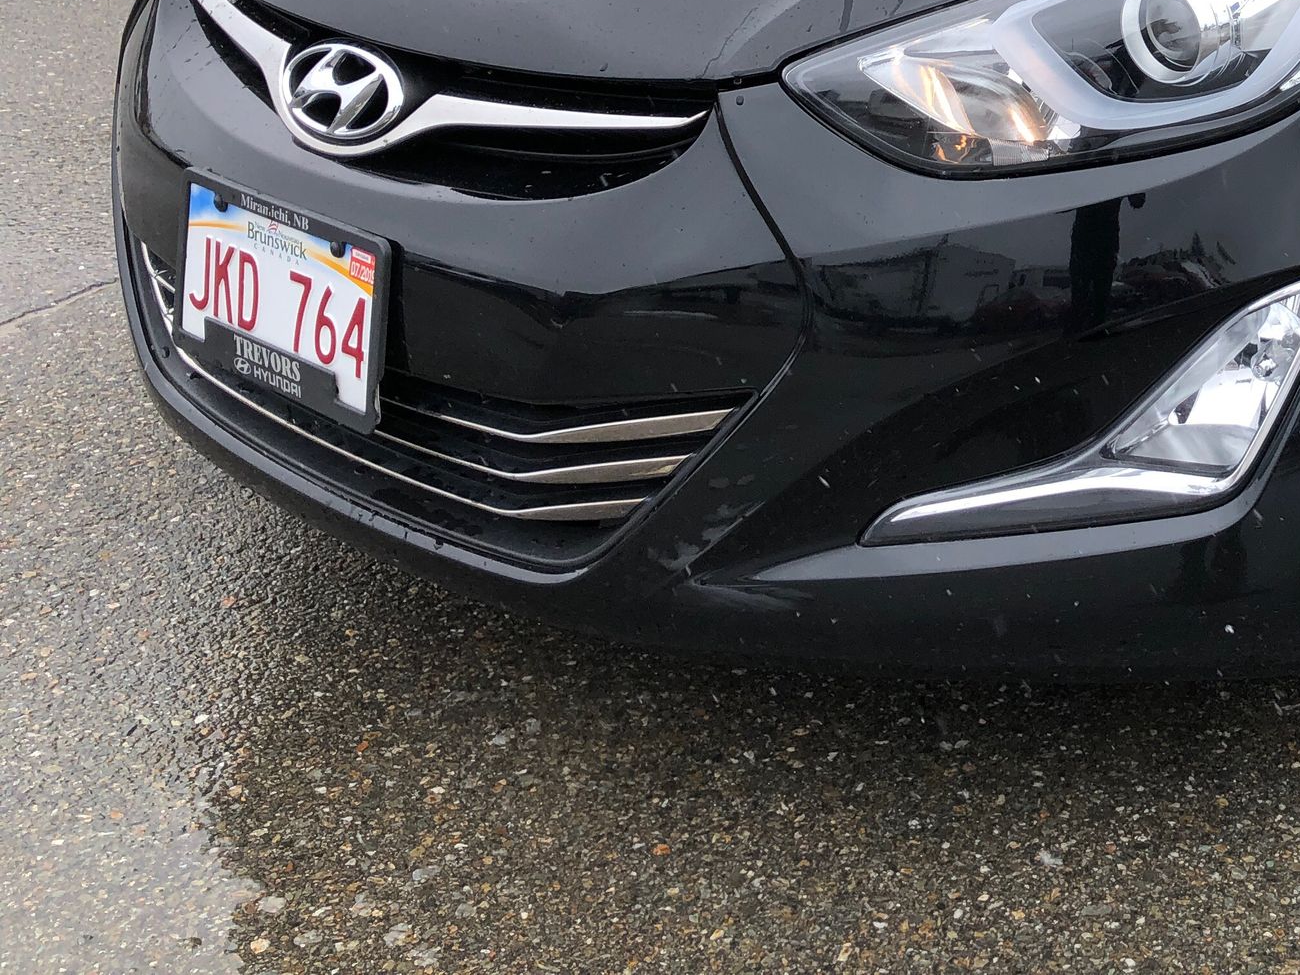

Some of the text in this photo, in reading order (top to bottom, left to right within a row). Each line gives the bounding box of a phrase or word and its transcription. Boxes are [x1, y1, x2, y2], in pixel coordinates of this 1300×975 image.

[293, 212, 309, 231] NB
[247, 221, 307, 261] Brunswick
[253, 243, 300, 266] CANADA
[188, 236, 366, 379] JKD 764
[233, 333, 301, 382] TREVORS
[253, 365, 302, 399] HYUNDAI
